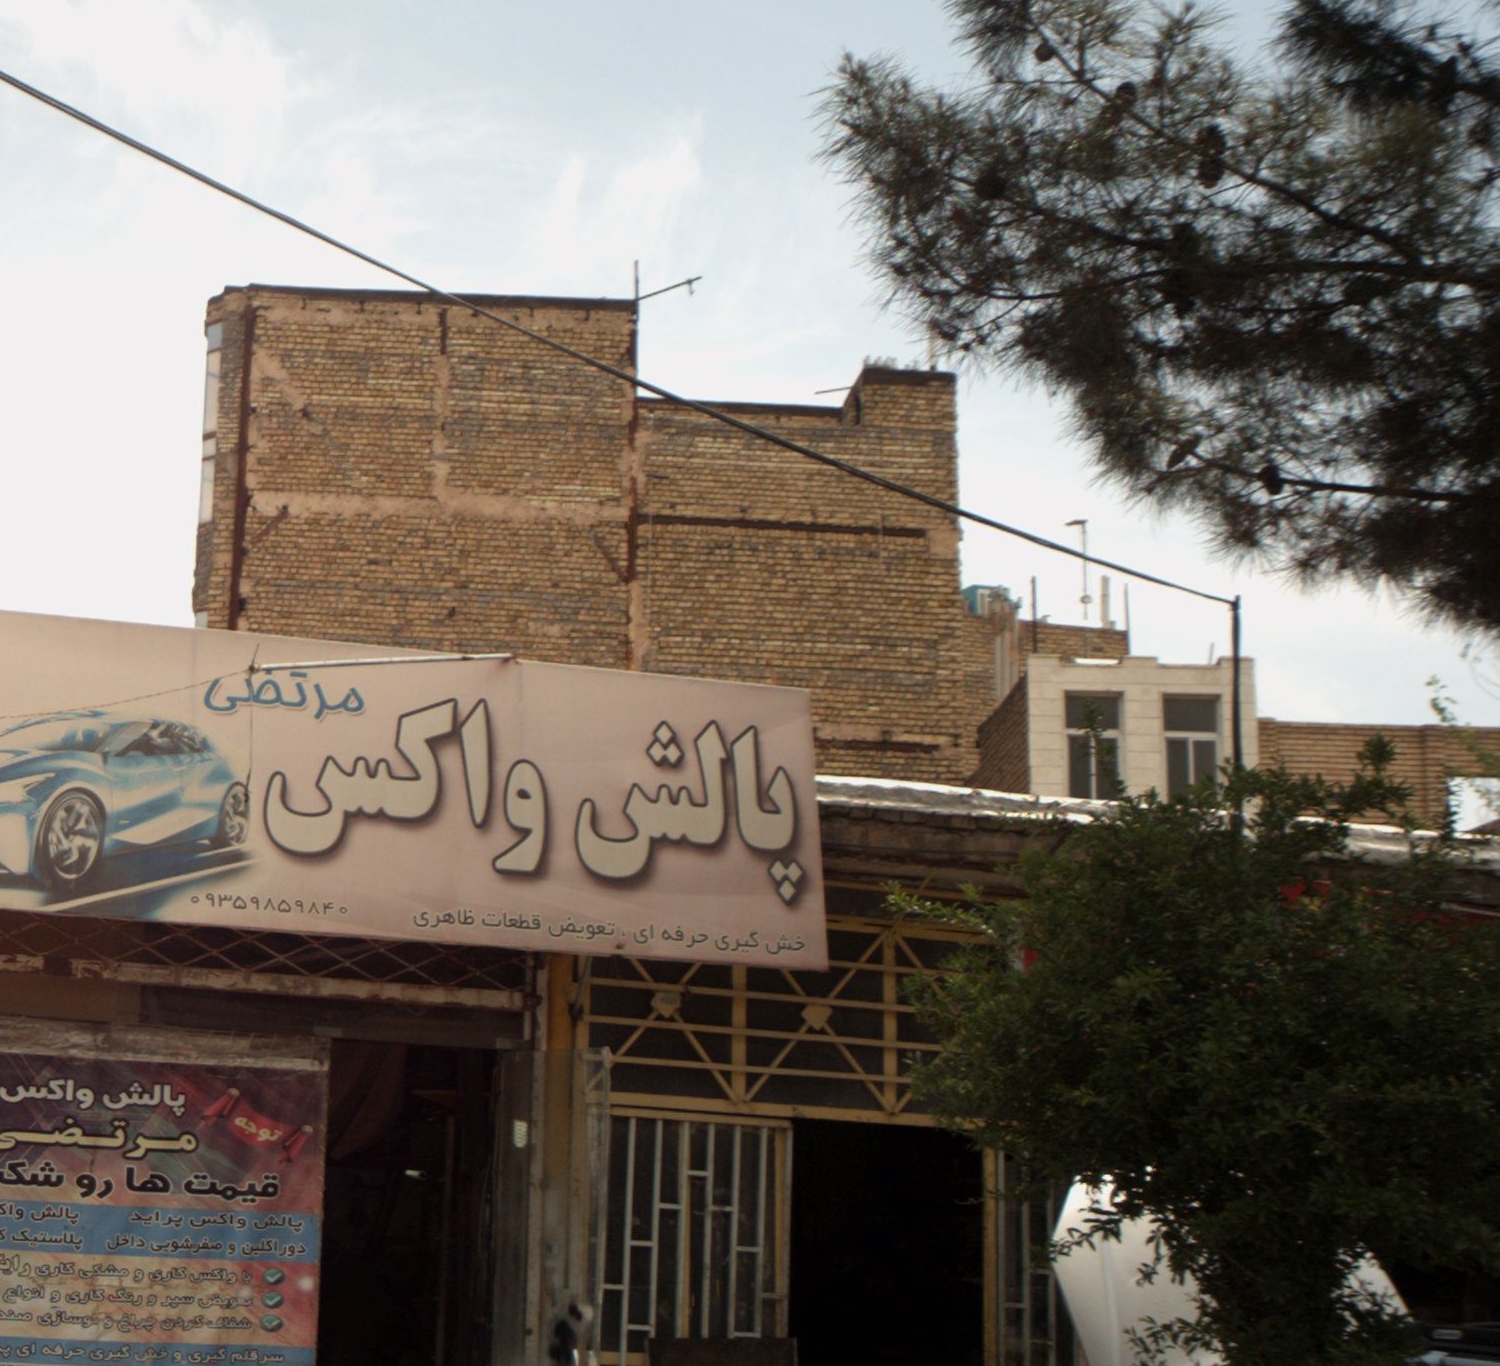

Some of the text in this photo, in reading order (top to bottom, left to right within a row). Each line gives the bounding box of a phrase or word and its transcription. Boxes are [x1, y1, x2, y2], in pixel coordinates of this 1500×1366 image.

[202, 669, 366, 720] مرتضی
[263, 697, 804, 907] پالش واکس
[413, 908, 806, 955] خش گیری حرفه ای تعویض قطعات ظاهری
[0, 1079, 187, 1118] پالش واکس
[233, 1115, 282, 1143] توجه
[76, 1172, 114, 1199] رو
[125, 1165, 172, 1194] ها
[183, 1172, 281, 1204] قیمت
[30, 1204, 80, 1225] پالش
[130, 1210, 304, 1233] پالش واکس پراید
[35, 1262, 76, 1277] کاری
[41, 1343, 86, 1360] حرفه
